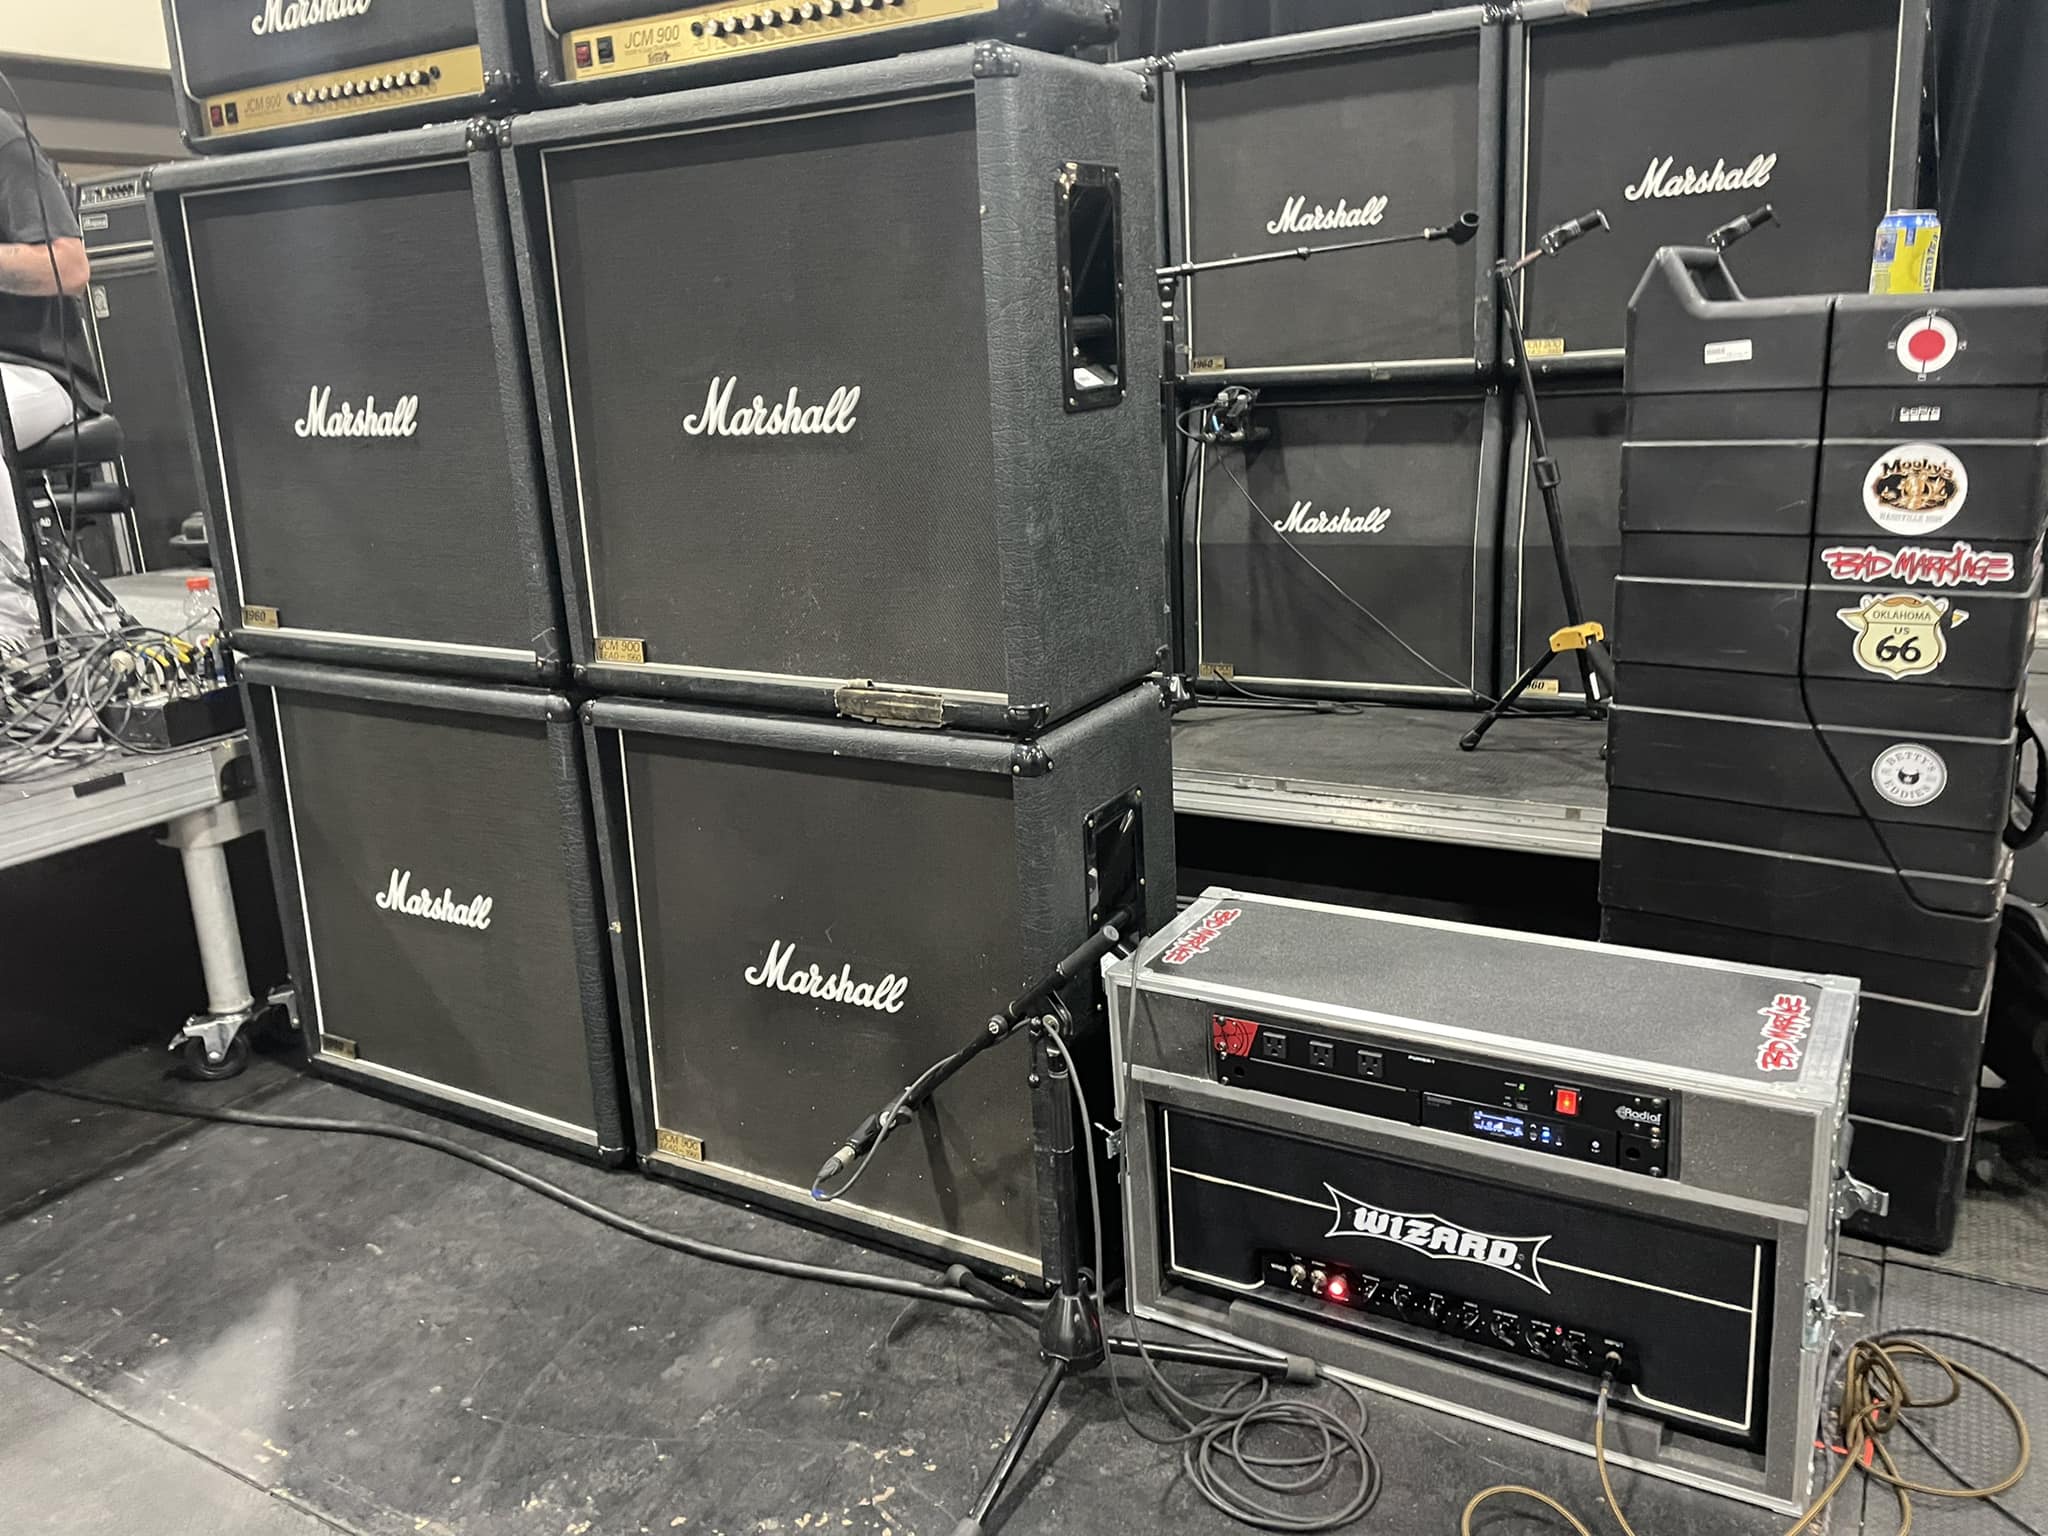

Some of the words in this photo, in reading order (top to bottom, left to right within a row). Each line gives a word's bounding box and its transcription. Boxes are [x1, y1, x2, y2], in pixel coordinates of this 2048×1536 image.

[623, 28, 653, 50] JCM
[656, 25, 680, 43] 900
[1624, 152, 1777, 201] Marshall
[1266, 194, 1388, 234] Marshall
[294, 384, 418, 438] Marshall
[683, 375, 861, 436] Marshall
[1273, 500, 1392, 534] Marshall
[1823, 550, 1893, 578] BAD
[245, 610, 266, 622] 1960
[1872, 609, 1932, 622] OKLAHOMA
[1894, 626, 1910, 636] US
[598, 640, 619, 651] JCM
[621, 642, 641, 653] 900
[1875, 635, 1922, 663] 66
[375, 867, 493, 930] Marshall
[744, 939, 909, 1014] Marshall
[1624, 1106, 1662, 1125] Radial
